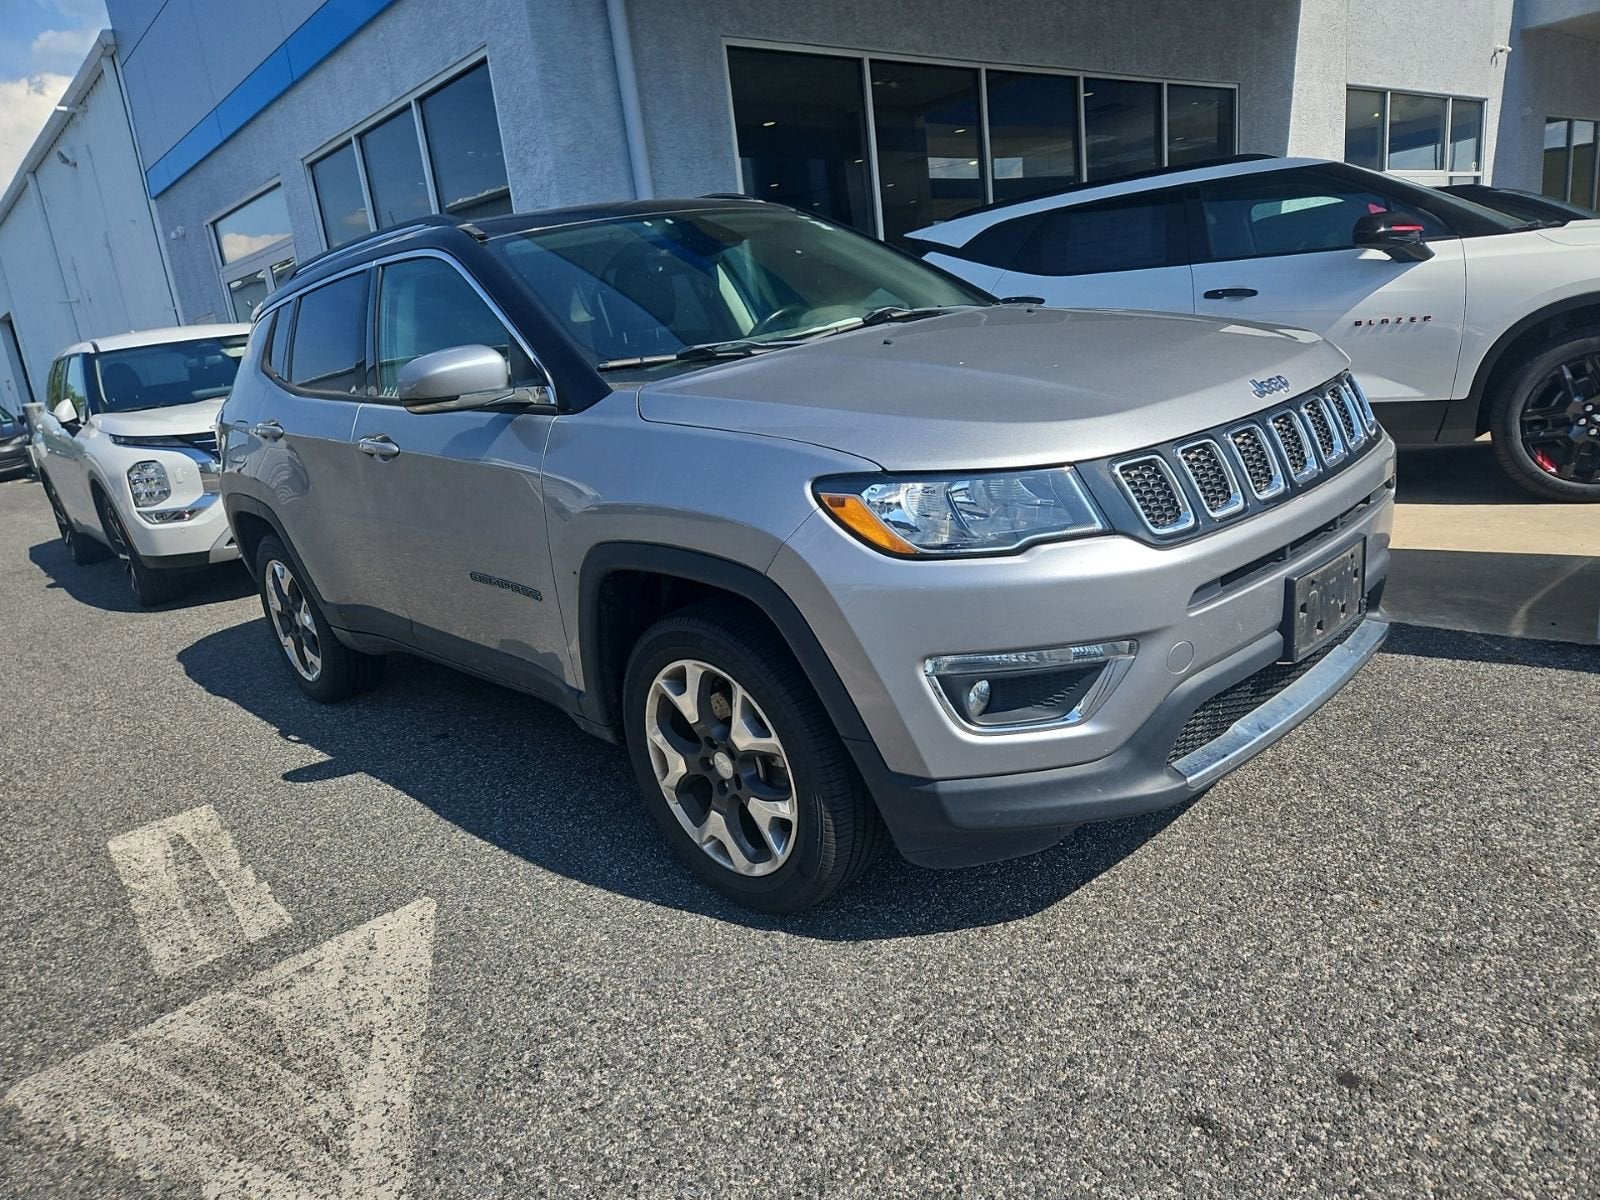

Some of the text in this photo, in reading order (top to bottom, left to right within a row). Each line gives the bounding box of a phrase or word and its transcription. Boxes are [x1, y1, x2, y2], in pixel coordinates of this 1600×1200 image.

[1354, 315, 1432, 327] BLAZER
[1249, 375, 1290, 399] Jeep
[469, 570, 543, 602] COMPASS
